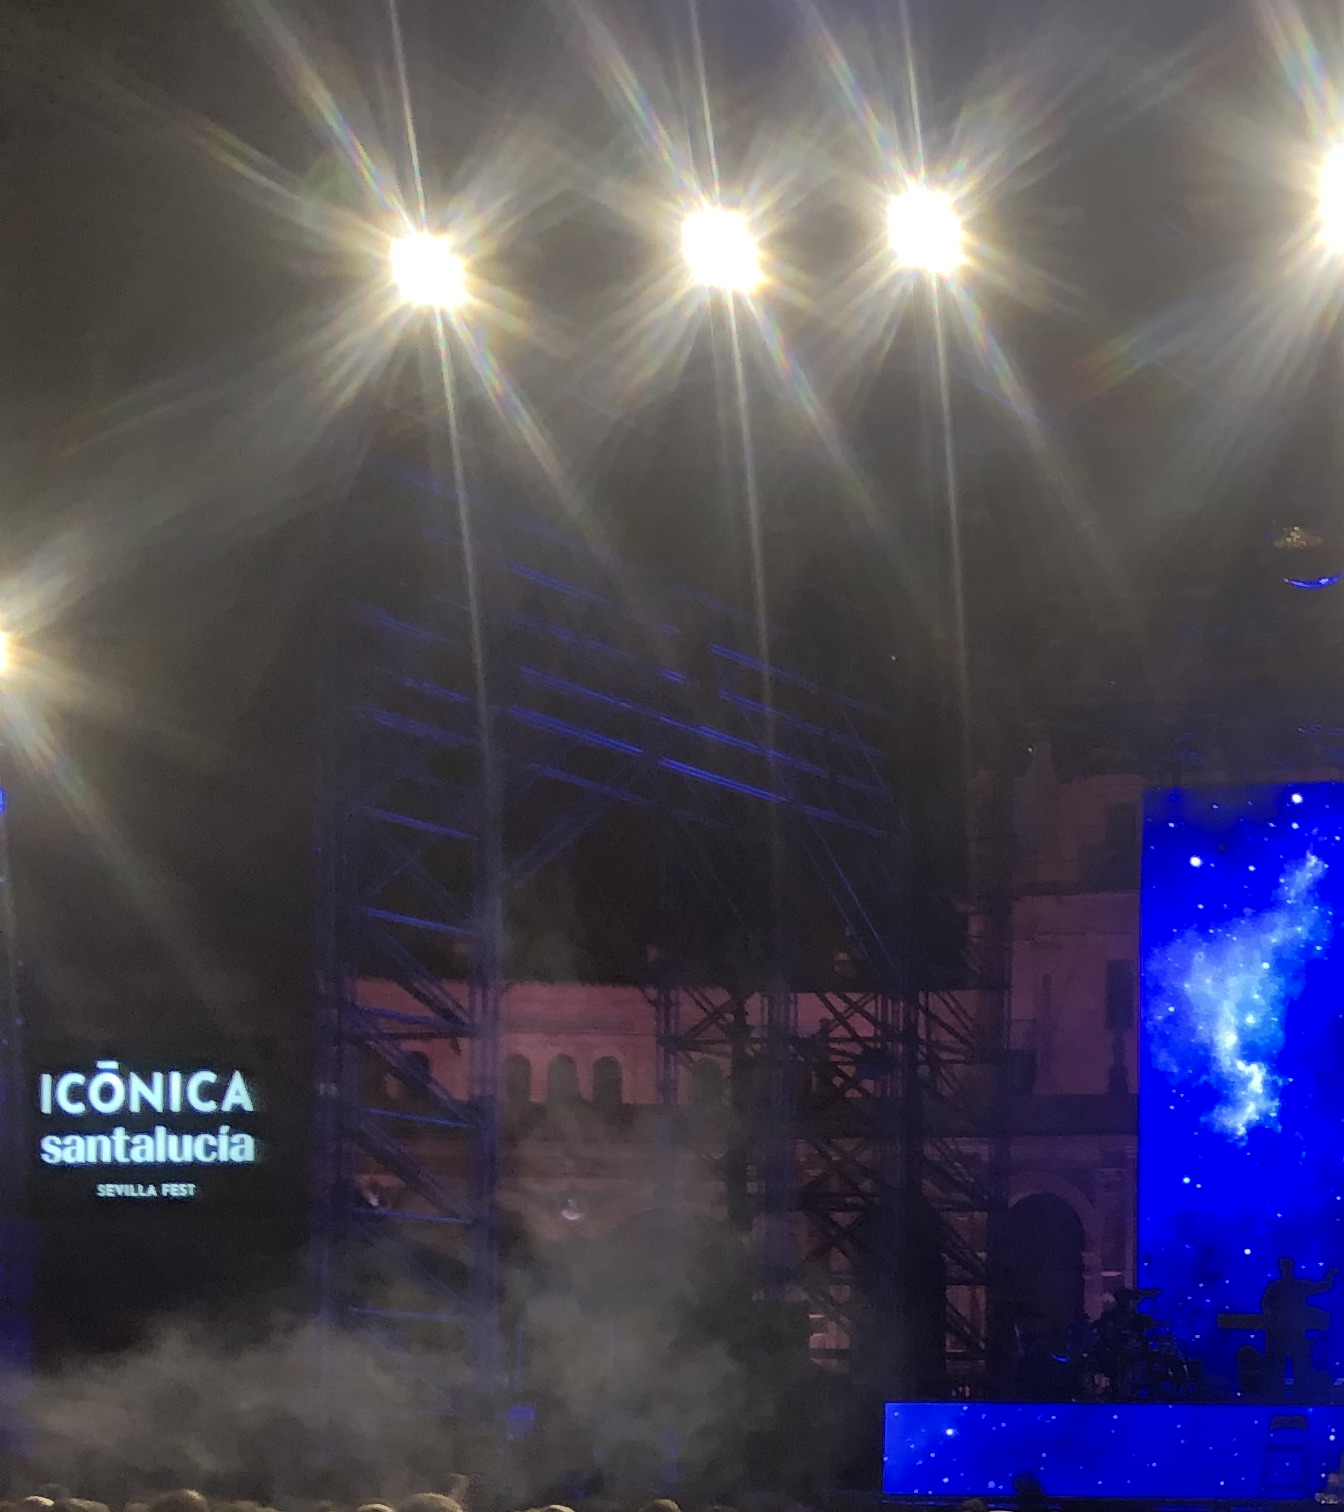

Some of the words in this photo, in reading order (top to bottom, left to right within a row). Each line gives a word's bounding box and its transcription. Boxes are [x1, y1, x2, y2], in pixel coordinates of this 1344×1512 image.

[40, 1124, 256, 1166] santalucía
[96, 1183, 158, 1198] SEVILLA
[161, 1183, 197, 1197] FEST
